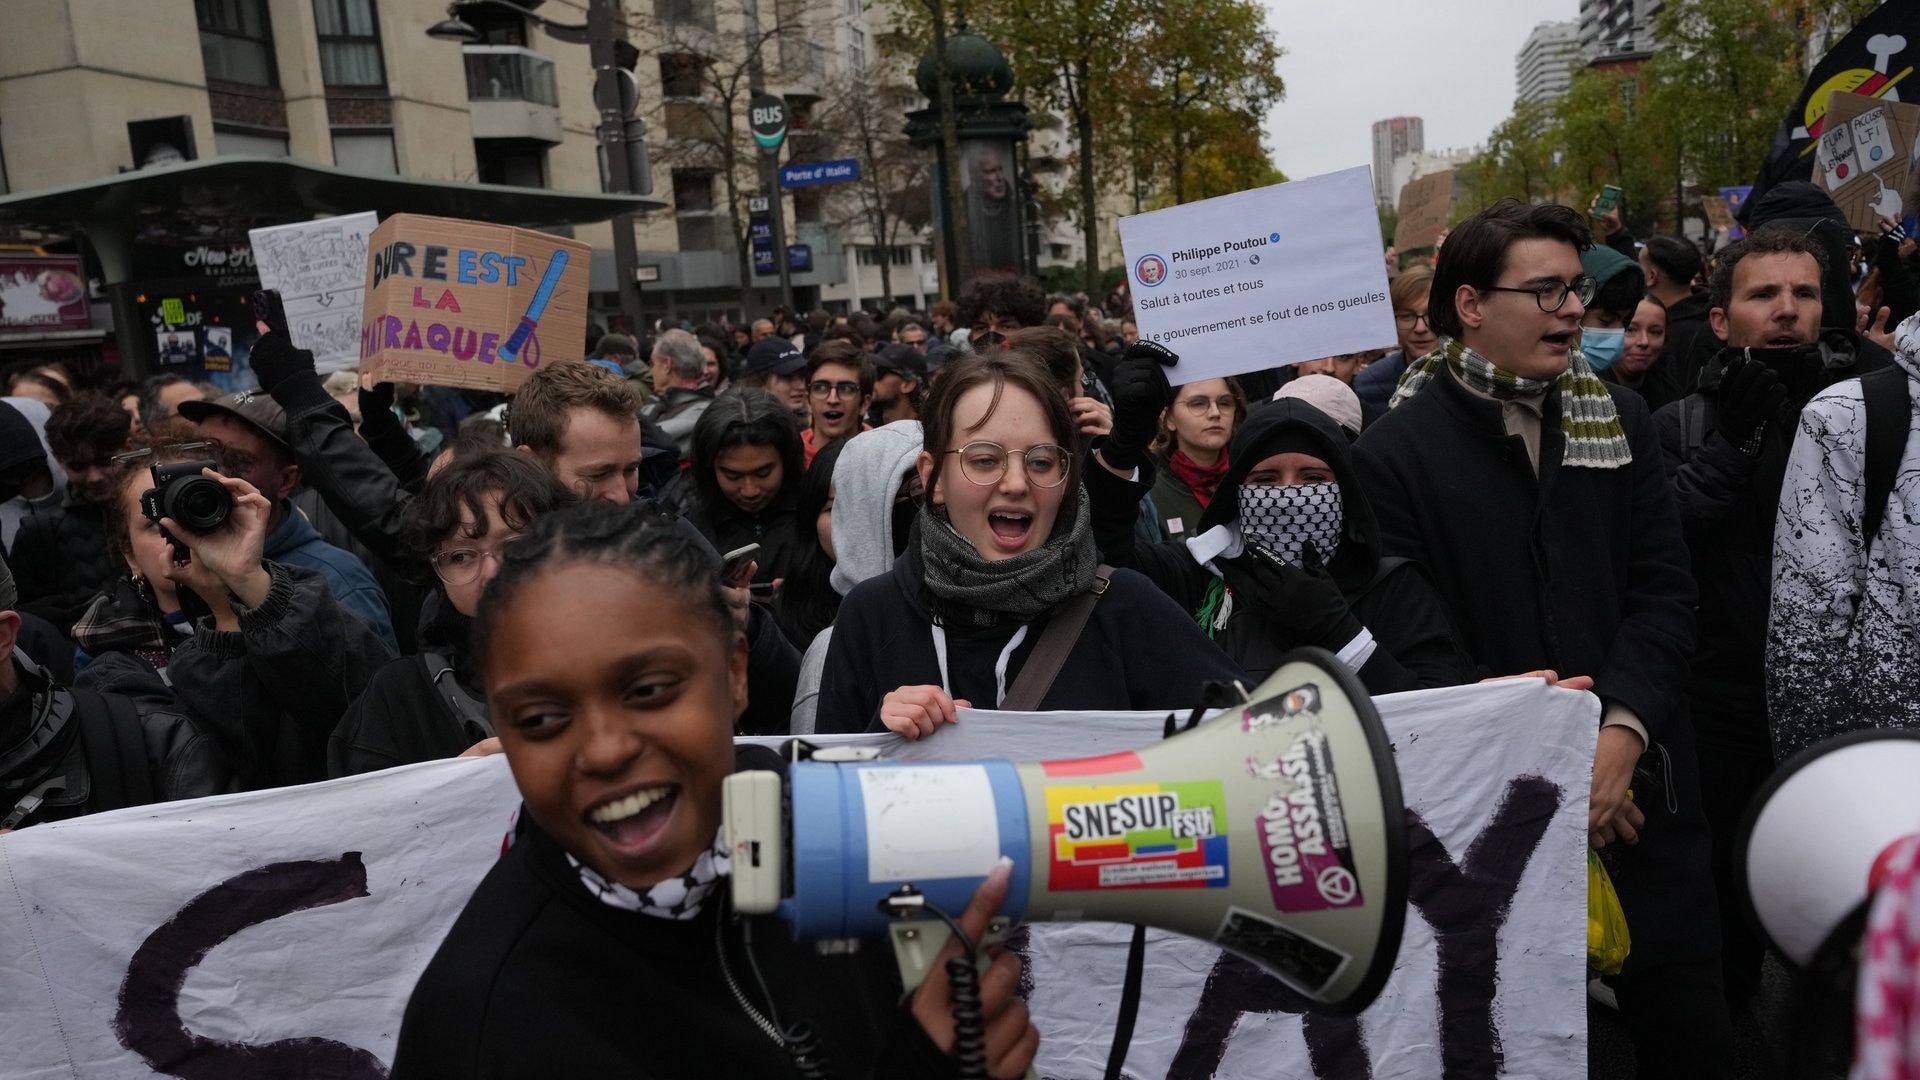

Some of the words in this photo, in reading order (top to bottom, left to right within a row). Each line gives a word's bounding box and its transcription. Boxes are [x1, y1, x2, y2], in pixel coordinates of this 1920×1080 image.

[752, 105, 783, 125] BUS
[1858, 125, 1880, 144] LFI
[786, 170, 813, 182] Porte
[825, 165, 852, 177] Italie
[184, 246, 227, 266] New
[1172, 246, 1221, 263] Philippe
[1224, 237, 1267, 253] Poutou
[373, 240, 449, 290] DURE
[457, 249, 526, 286] EST
[1175, 270, 1188, 280] 30
[1190, 265, 1213, 278] sept.
[1216, 259, 1240, 272] 2021
[412, 286, 461, 313] LA
[1140, 296, 1170, 310] Salut
[1173, 293, 1181, 304] à
[1182, 287, 1220, 302] toutes
[1223, 283, 1235, 294] et
[1238, 279, 1264, 292] tous
[1163, 316, 1247, 343] gouvernement
[1249, 314, 1264, 325] se
[1267, 308, 1291, 321] fout
[1294, 305, 1309, 316] de
[1312, 301, 1335, 313] nos
[1338, 292, 1386, 311] gueules
[360, 314, 500, 364] MATRAQUE
[1066, 795, 1175, 840] SNESUP
[1173, 812, 1211, 837] FSU
